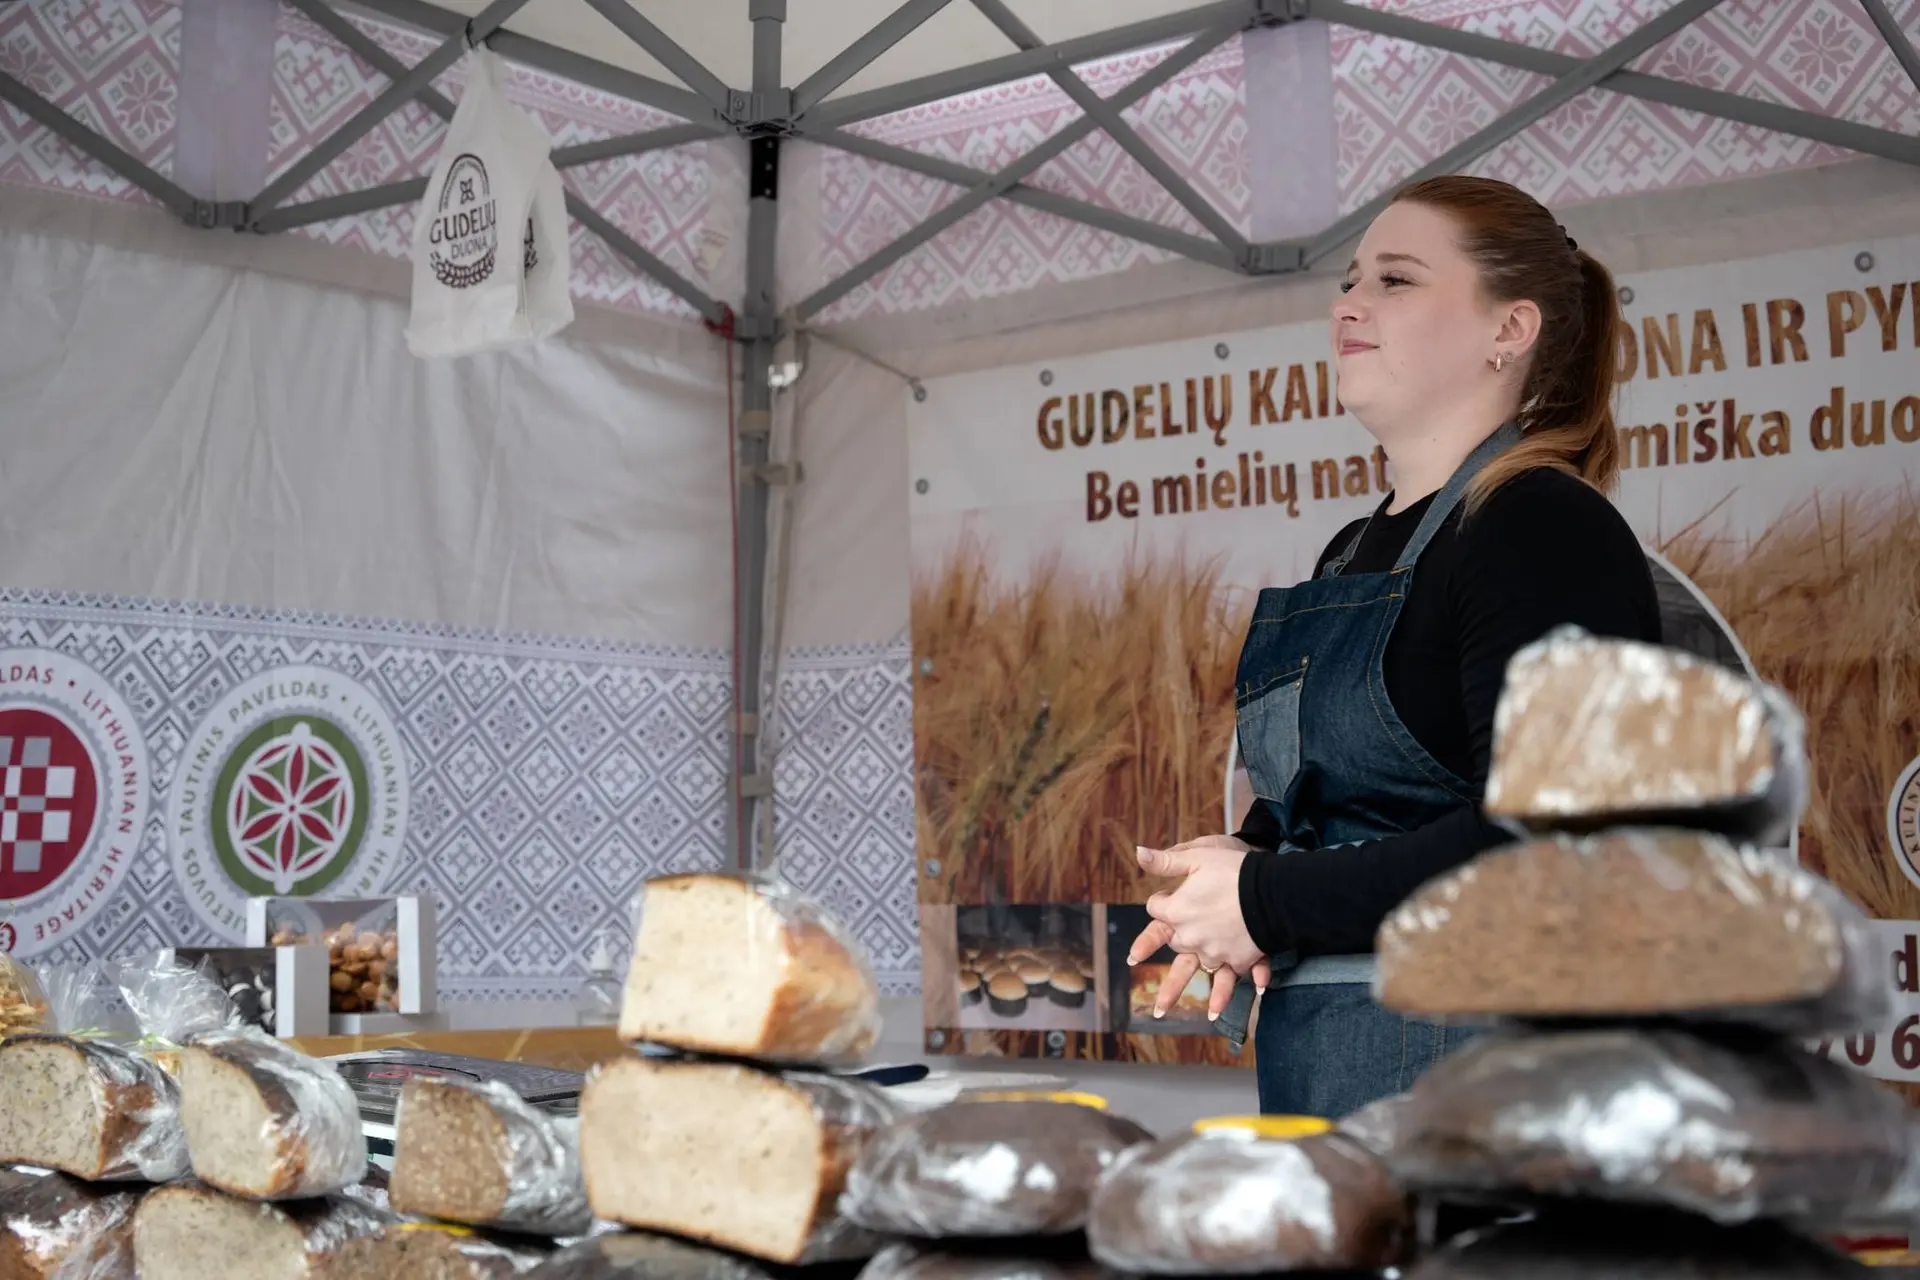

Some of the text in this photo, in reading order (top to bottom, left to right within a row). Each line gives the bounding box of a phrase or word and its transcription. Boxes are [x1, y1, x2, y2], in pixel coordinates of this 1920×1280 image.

[450, 235, 489, 260] DUONA
[1037, 373, 1234, 451] GUDELIŲ
[1248, 360, 1346, 427] KAI
[1615, 307, 1728, 384] ONA
[1741, 297, 1810, 368] IR
[1086, 386, 1920, 523] Be mielių nat miška duo
[228, 680, 331, 724] PAVELDAS
[81, 689, 138, 835] LITHUANIAN
[178, 725, 225, 837] TAUTINIS
[352, 704, 399, 838] LITHUANIAN
[34, 846, 123, 942] HERITAGE
[352, 848, 389, 899] HERI
[1891, 934, 1920, 993] d
[1891, 1013, 1920, 1071] 6
